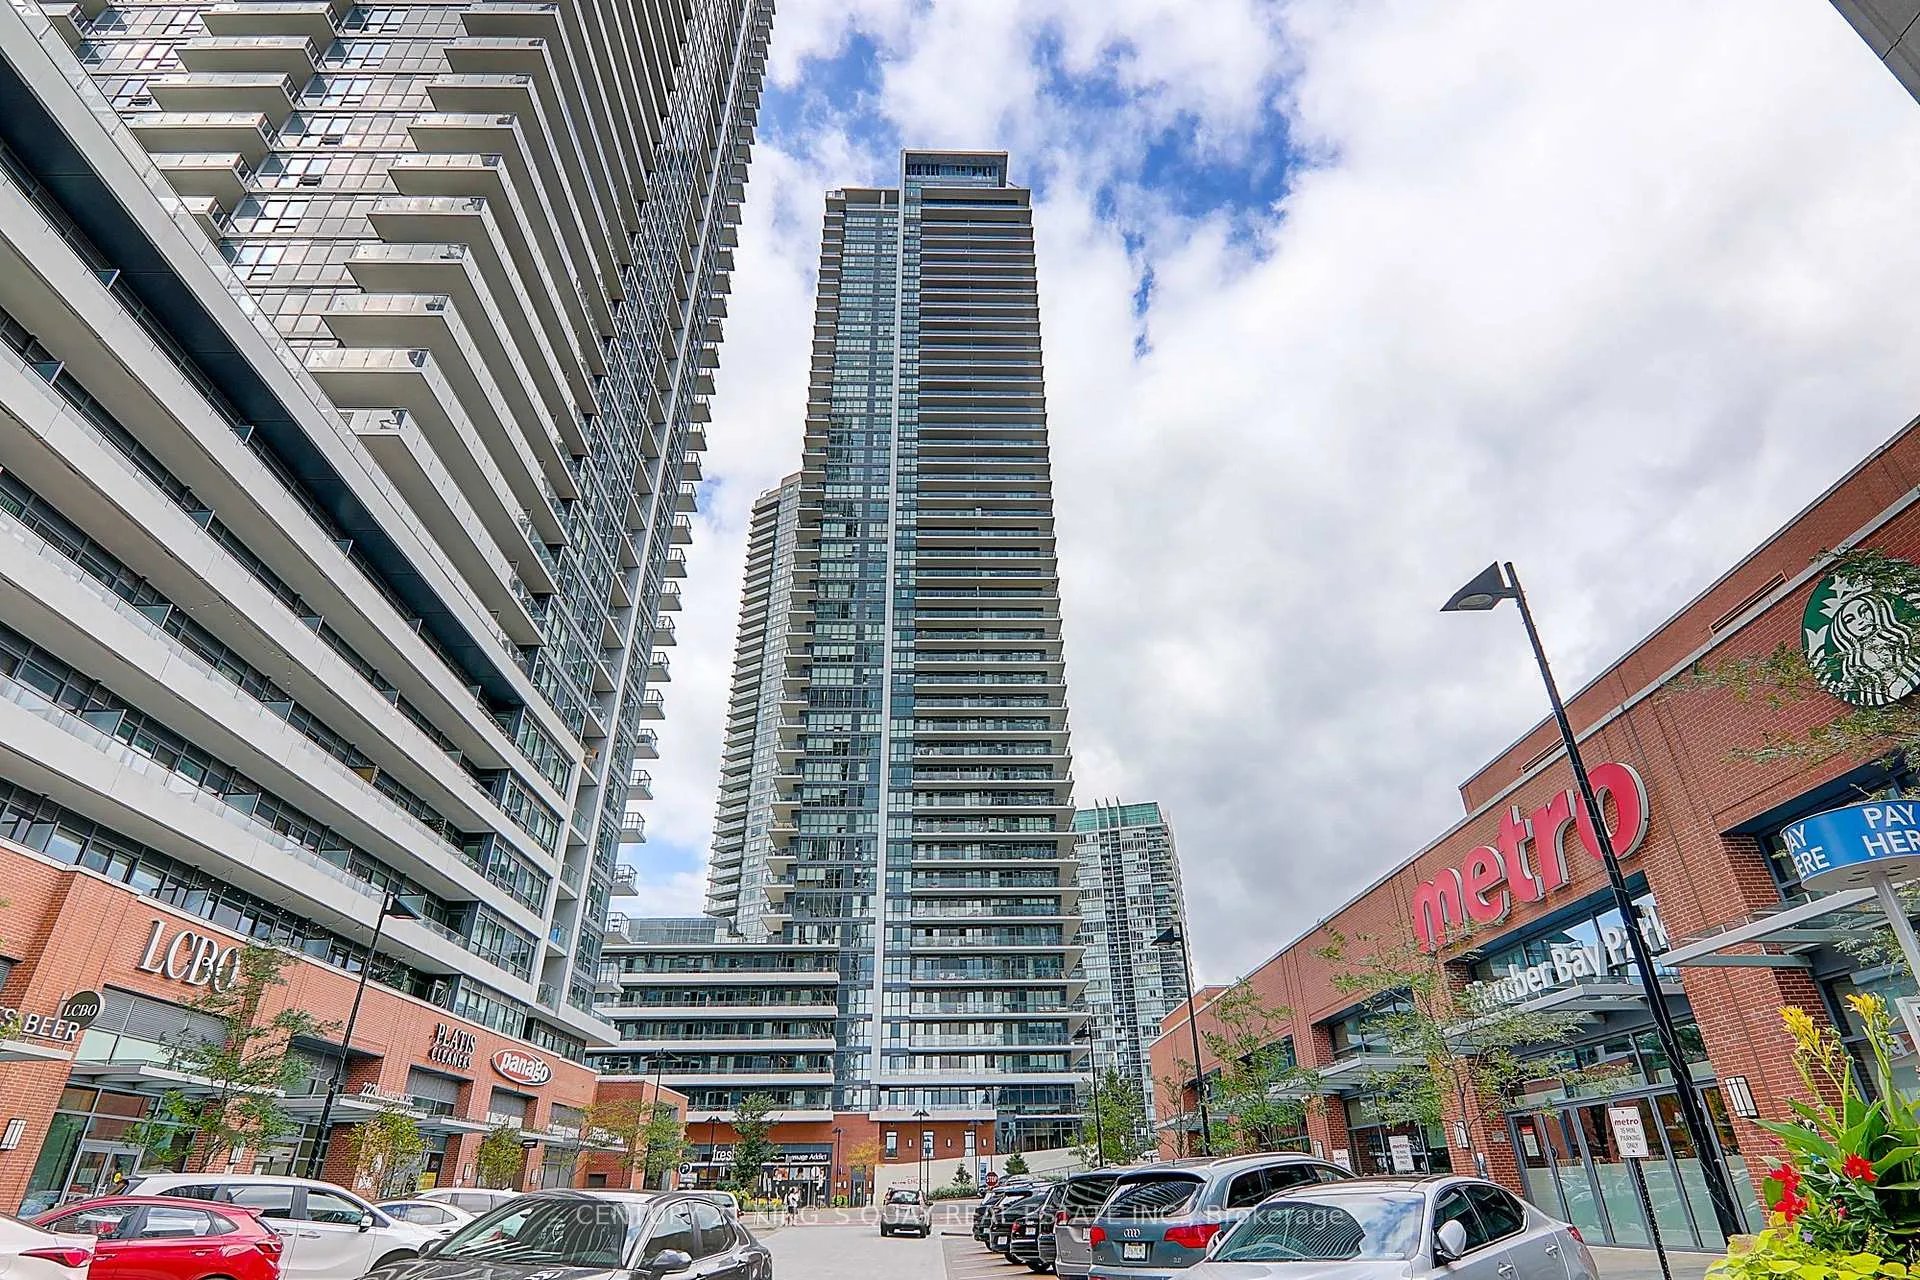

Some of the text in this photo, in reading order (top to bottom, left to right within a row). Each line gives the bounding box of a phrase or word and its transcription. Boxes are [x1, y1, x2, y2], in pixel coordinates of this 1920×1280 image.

[1862, 804, 1917, 829] PAY
[1412, 762, 1649, 954] metro
[1862, 830, 1920, 857] HER
[1794, 846, 1830, 878] ERE
[138, 918, 241, 993] LCBO
[1551, 941, 1609, 984] Bay
[63, 1002, 99, 1018] LCBO
[23, 1013, 80, 1043] BEER
[434, 1022, 477, 1056] PLATIS
[431, 1046, 472, 1069] CLEANERS
[500, 1052, 549, 1082] panago
[1615, 1118, 1639, 1126] metro
